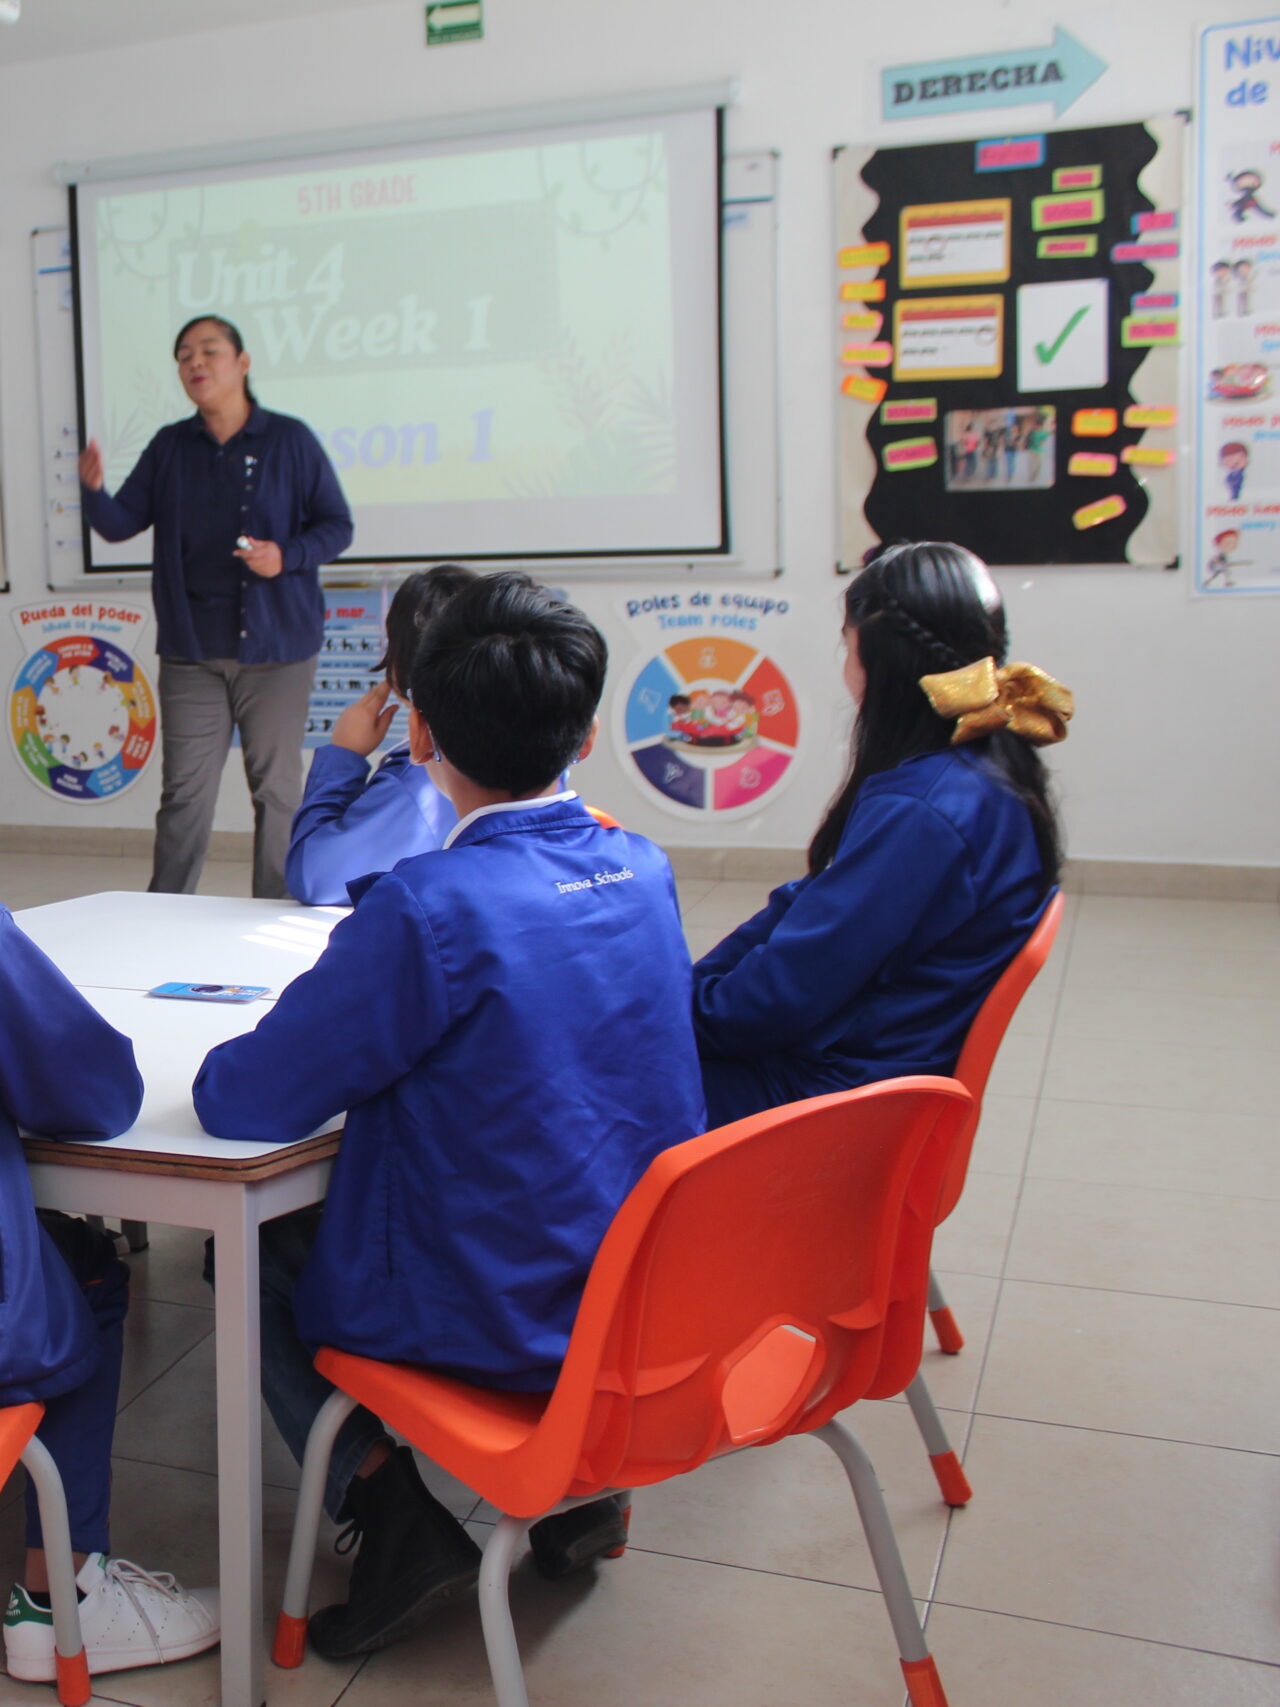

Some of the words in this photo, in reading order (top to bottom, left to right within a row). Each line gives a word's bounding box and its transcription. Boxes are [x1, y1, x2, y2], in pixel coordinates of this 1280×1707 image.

[893, 61, 1064, 105] DERECHA
[1226, 80, 1268, 107] de
[297, 181, 341, 215] 5TH
[350, 174, 418, 210] GRADE
[175, 246, 298, 308] Unit
[304, 243, 345, 307] 4
[254, 294, 438, 366] Week
[463, 297, 494, 351] 1
[466, 409, 497, 463] 1
[20, 605, 66, 625] Rueda
[72, 604, 93, 617] del
[99, 605, 142, 625] poder
[626, 594, 680, 618] Roles
[690, 592, 712, 607] de
[721, 593, 789, 614] equipo
[658, 614, 705, 631] Team
[711, 613, 757, 631] roles
[555, 878, 594, 895] Innova
[594, 866, 634, 886] Schools
